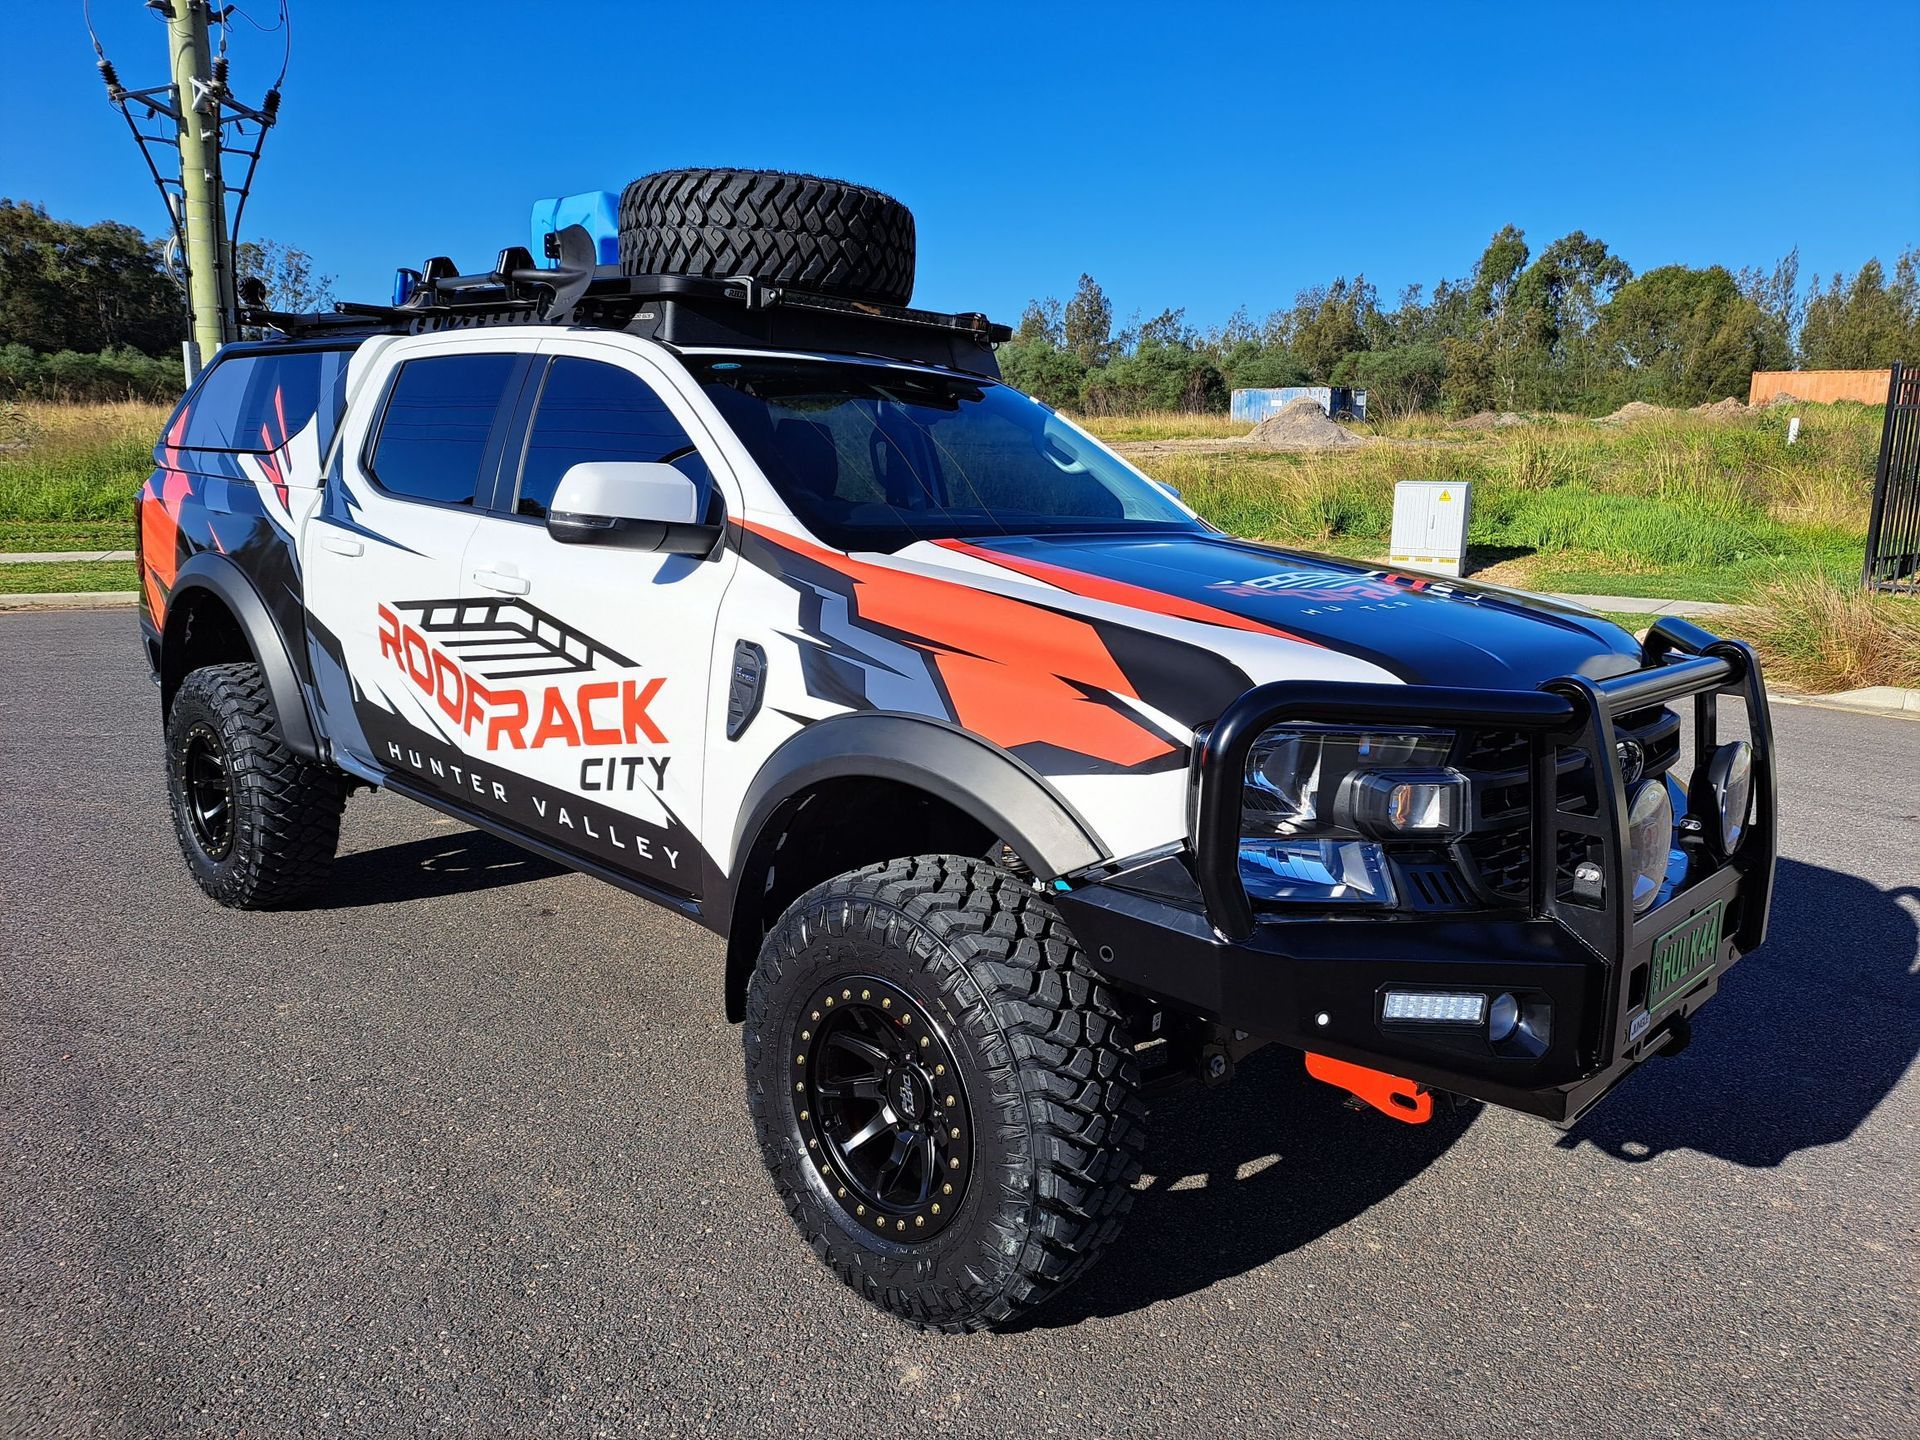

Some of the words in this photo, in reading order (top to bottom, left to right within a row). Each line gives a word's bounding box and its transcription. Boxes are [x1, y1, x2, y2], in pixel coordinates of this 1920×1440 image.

[387, 741, 508, 803] HUNTER
[532, 796, 679, 869] VALLEY
[580, 756, 671, 791] CITY
[1660, 915, 1717, 992] HULK44
